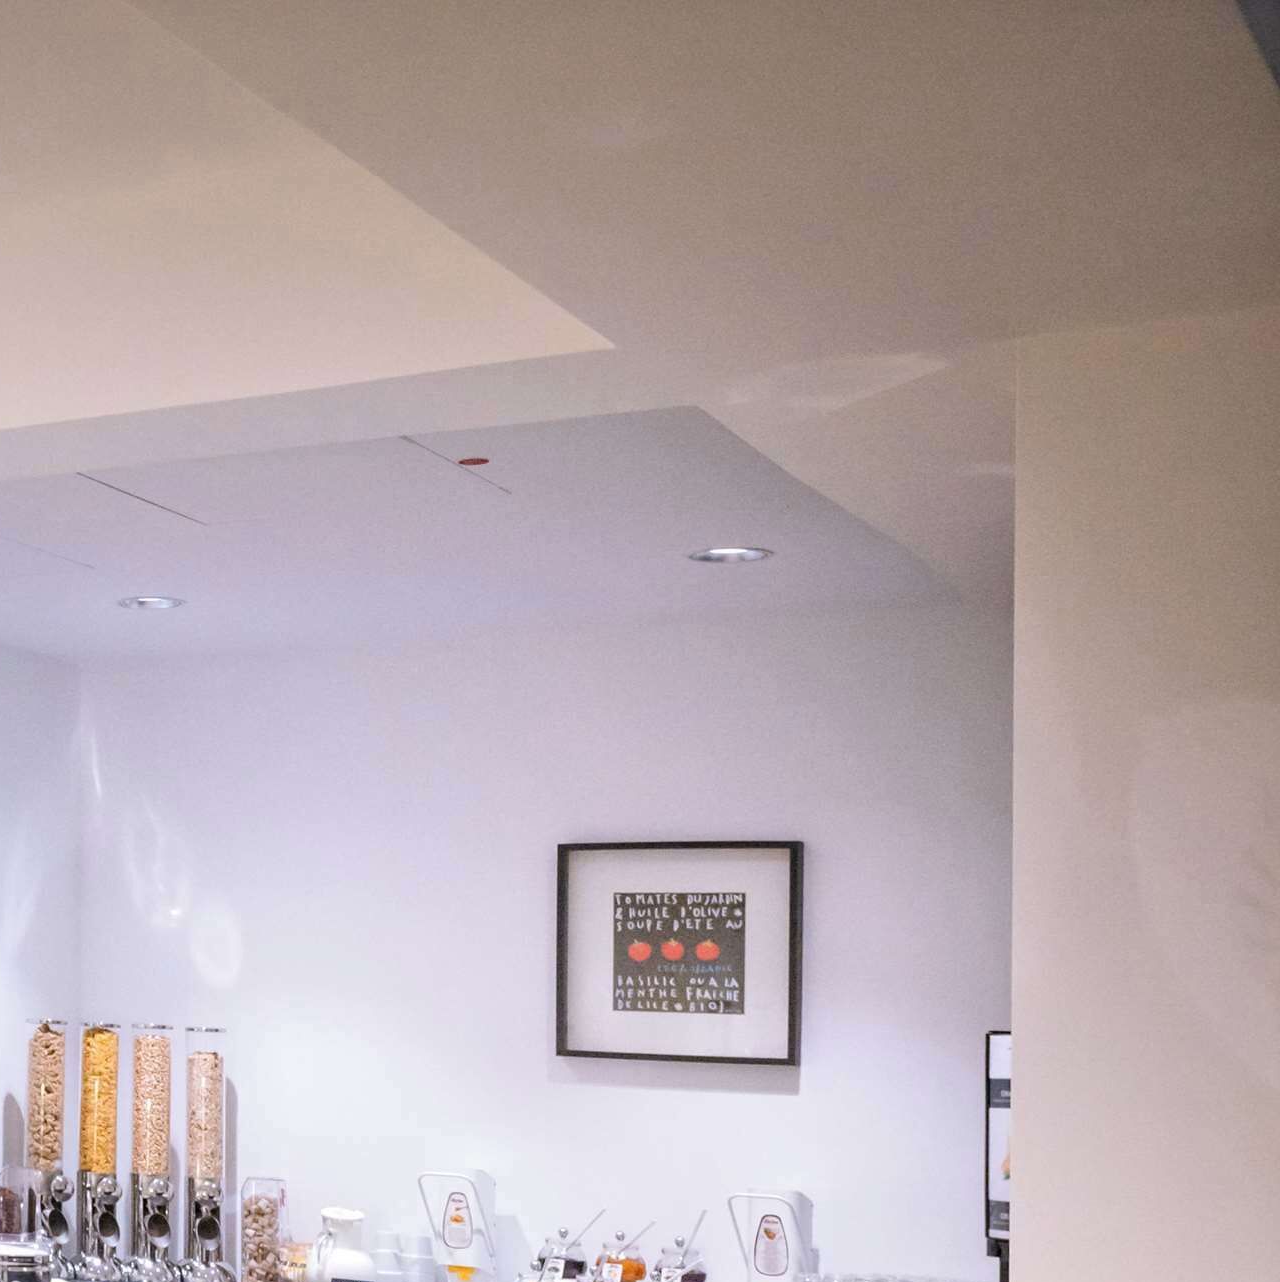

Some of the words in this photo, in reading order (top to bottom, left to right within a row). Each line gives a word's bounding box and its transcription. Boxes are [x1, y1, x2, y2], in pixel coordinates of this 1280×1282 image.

[615, 894, 678, 905] TOMATES
[629, 906, 670, 919] HUILE
[616, 919, 664, 933] SOUPE
[725, 919, 743, 930] AU
[617, 975, 677, 987] BASILIC
[724, 977, 740, 989] LA
[615, 988, 678, 999] MENTHE
